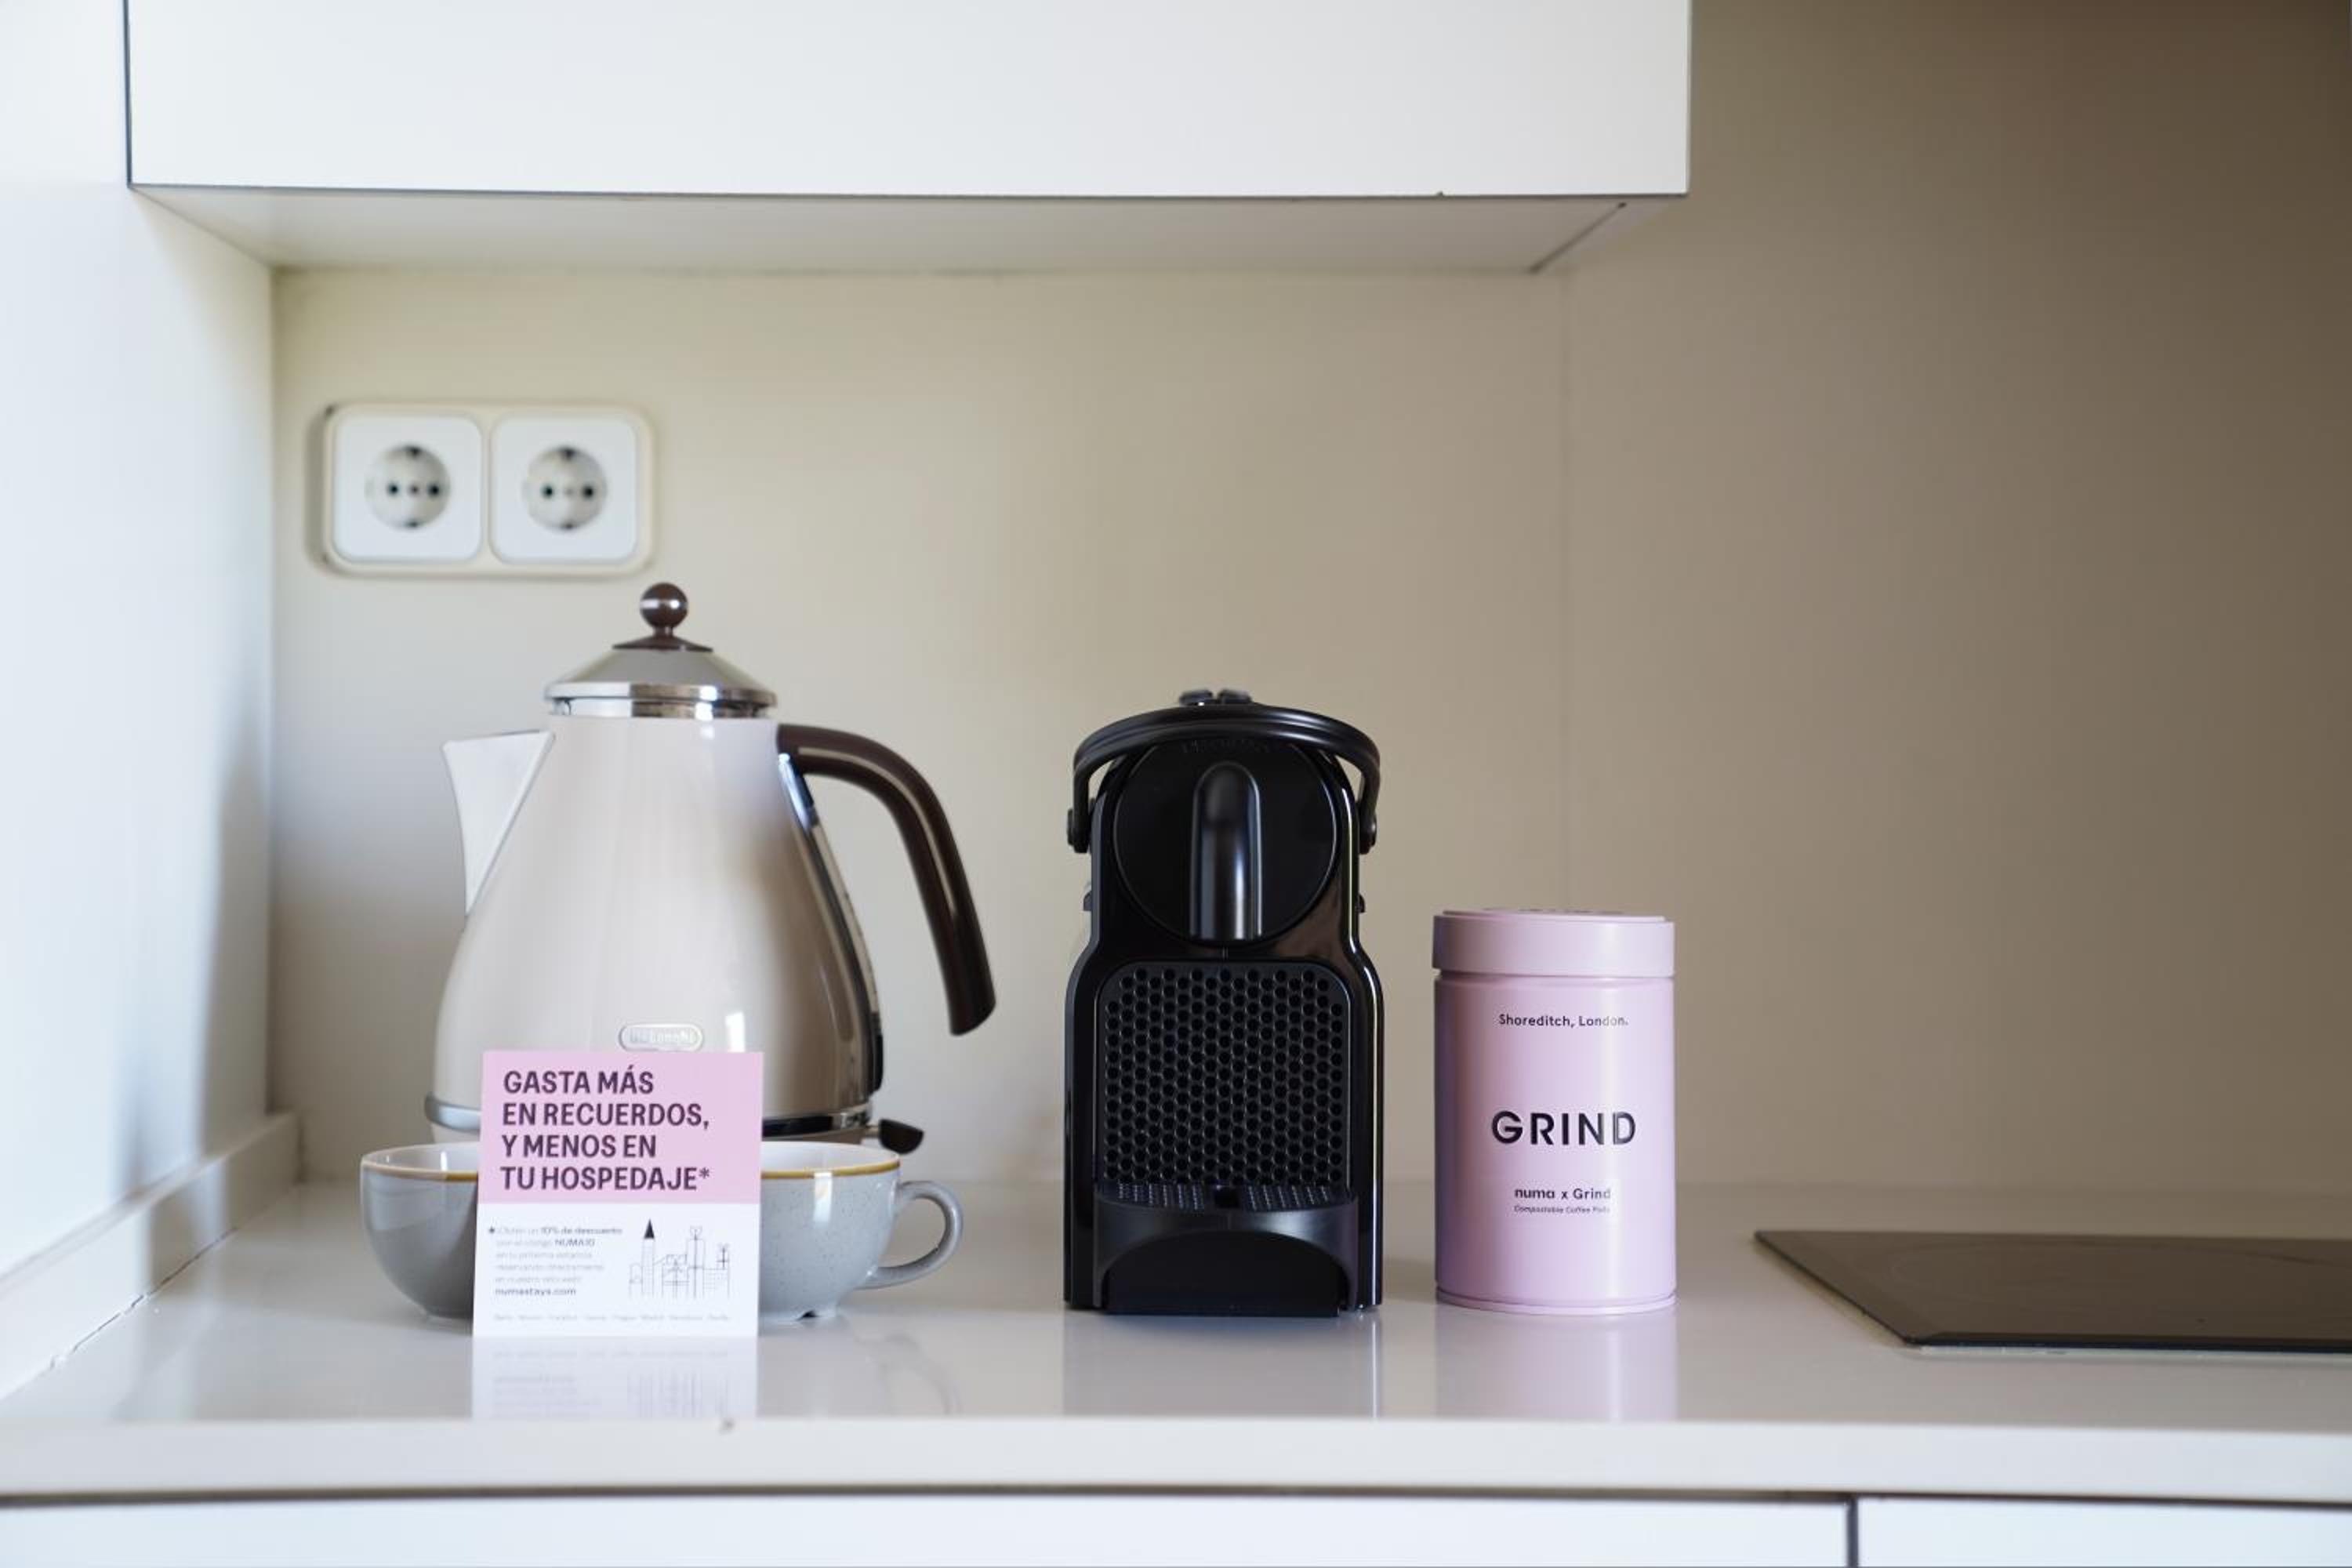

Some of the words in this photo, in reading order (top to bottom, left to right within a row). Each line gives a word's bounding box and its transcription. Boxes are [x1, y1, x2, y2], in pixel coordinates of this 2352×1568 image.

[1499, 1014, 1575, 1028] Shoreditch,
[1579, 1016, 1629, 1026] London.
[503, 1071, 590, 1094] GASTA
[597, 1065, 654, 1094] MÁS
[503, 1103, 536, 1126] EN
[543, 1103, 709, 1129] RECUERDOS,
[1492, 1110, 1636, 1145] GRIND
[502, 1134, 517, 1157] Y
[523, 1134, 616, 1158] MENOS
[623, 1135, 656, 1158] EN
[500, 1167, 535, 1189] TU
[1514, 1189, 1555, 1199] numa
[1561, 1191, 1568, 1200] x
[1573, 1188, 1611, 1200] Grind
[1514, 1205, 1563, 1214] Compostable
